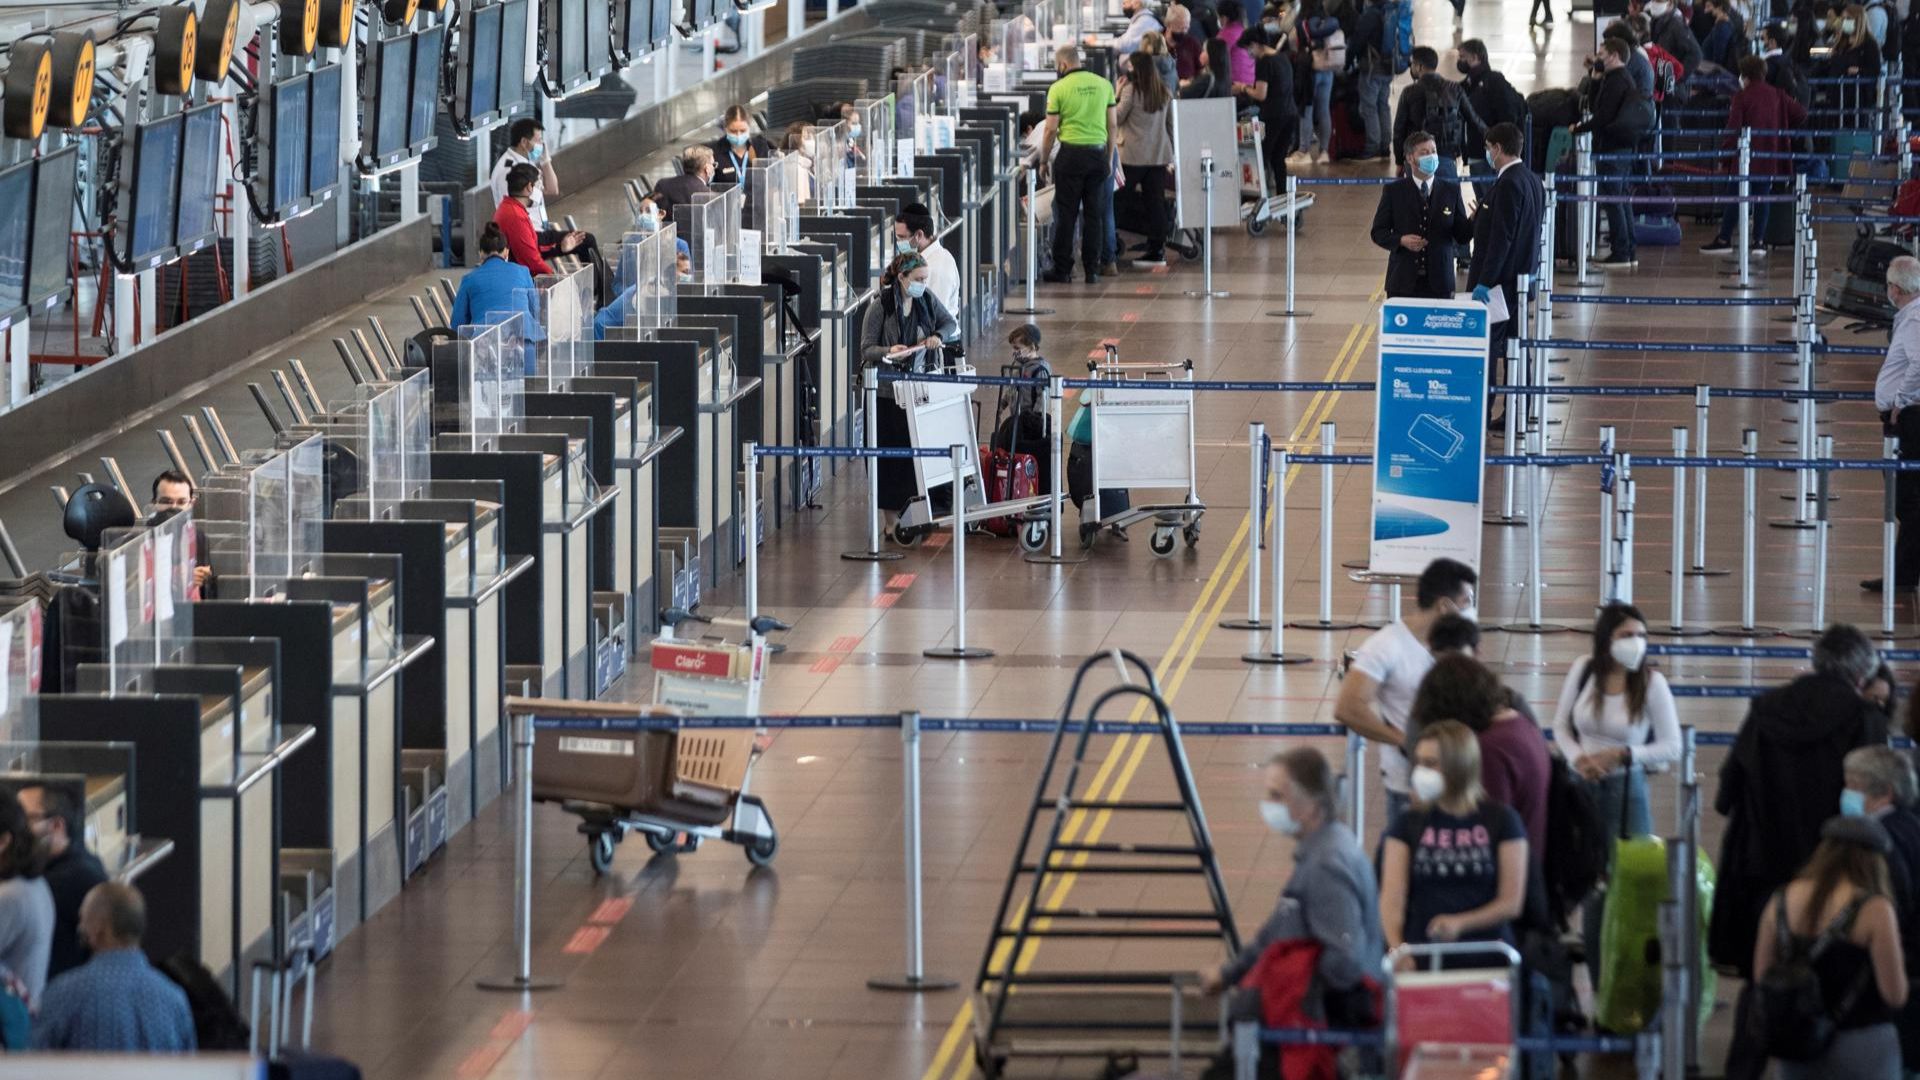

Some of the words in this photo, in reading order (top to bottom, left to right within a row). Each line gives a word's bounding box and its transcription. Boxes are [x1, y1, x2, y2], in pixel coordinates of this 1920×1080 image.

[75, 60, 92, 103] 07
[1423, 320, 1463, 329] Argentinas
[675, 654, 702, 669] Claro
[1420, 824, 1490, 848] AERO
